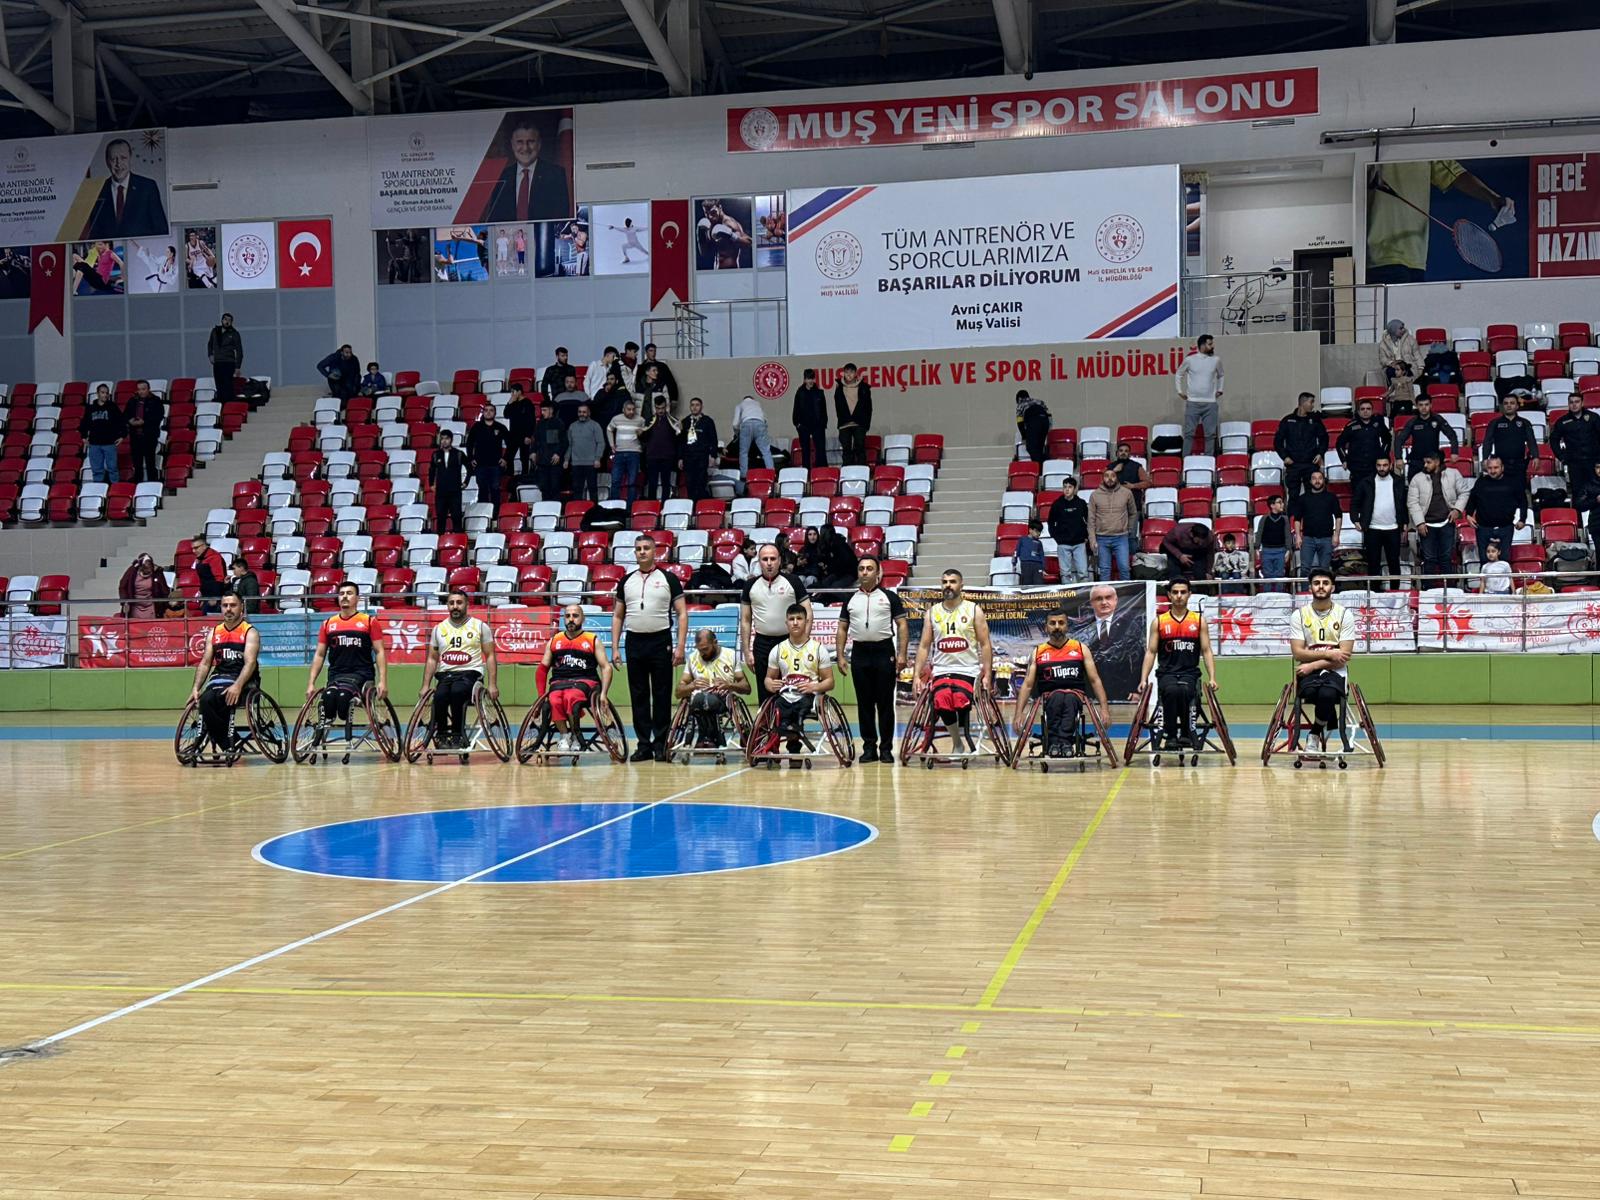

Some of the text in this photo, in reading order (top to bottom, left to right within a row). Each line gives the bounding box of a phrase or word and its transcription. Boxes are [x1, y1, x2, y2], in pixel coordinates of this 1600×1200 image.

[787, 78, 1295, 143] MUŞ YENİ SPOR SALONU
[445, 168, 456, 176] VE
[384, 177, 454, 189] SPORCULARIMIZA
[419, 187, 458, 195] DİLİYORUM
[881, 219, 1075, 250] TÜM ANTRENÖR VE
[888, 244, 1069, 271] SPORCULARIMIZA
[878, 267, 1081, 295] BAŞARILAR DİLİYORUM
[951, 301, 1023, 317] Avni ÇAKIR
[956, 316, 1021, 331] Muş Valisi
[950, 361, 976, 384] VE
[985, 358, 1042, 383] SPOR
[1050, 353, 1068, 381] İL
[1077, 346, 1198, 379] MÜDÜRLÜ
[946, 622, 956, 634] 14
[1165, 624, 1171, 634] 11
[215, 634, 221, 643] 5
[1319, 628, 1325, 641] 0
[450, 636, 462, 648] 49
[556, 640, 562, 650] 6
[1041, 652, 1050, 661] 21
[794, 658, 800, 671] 5
